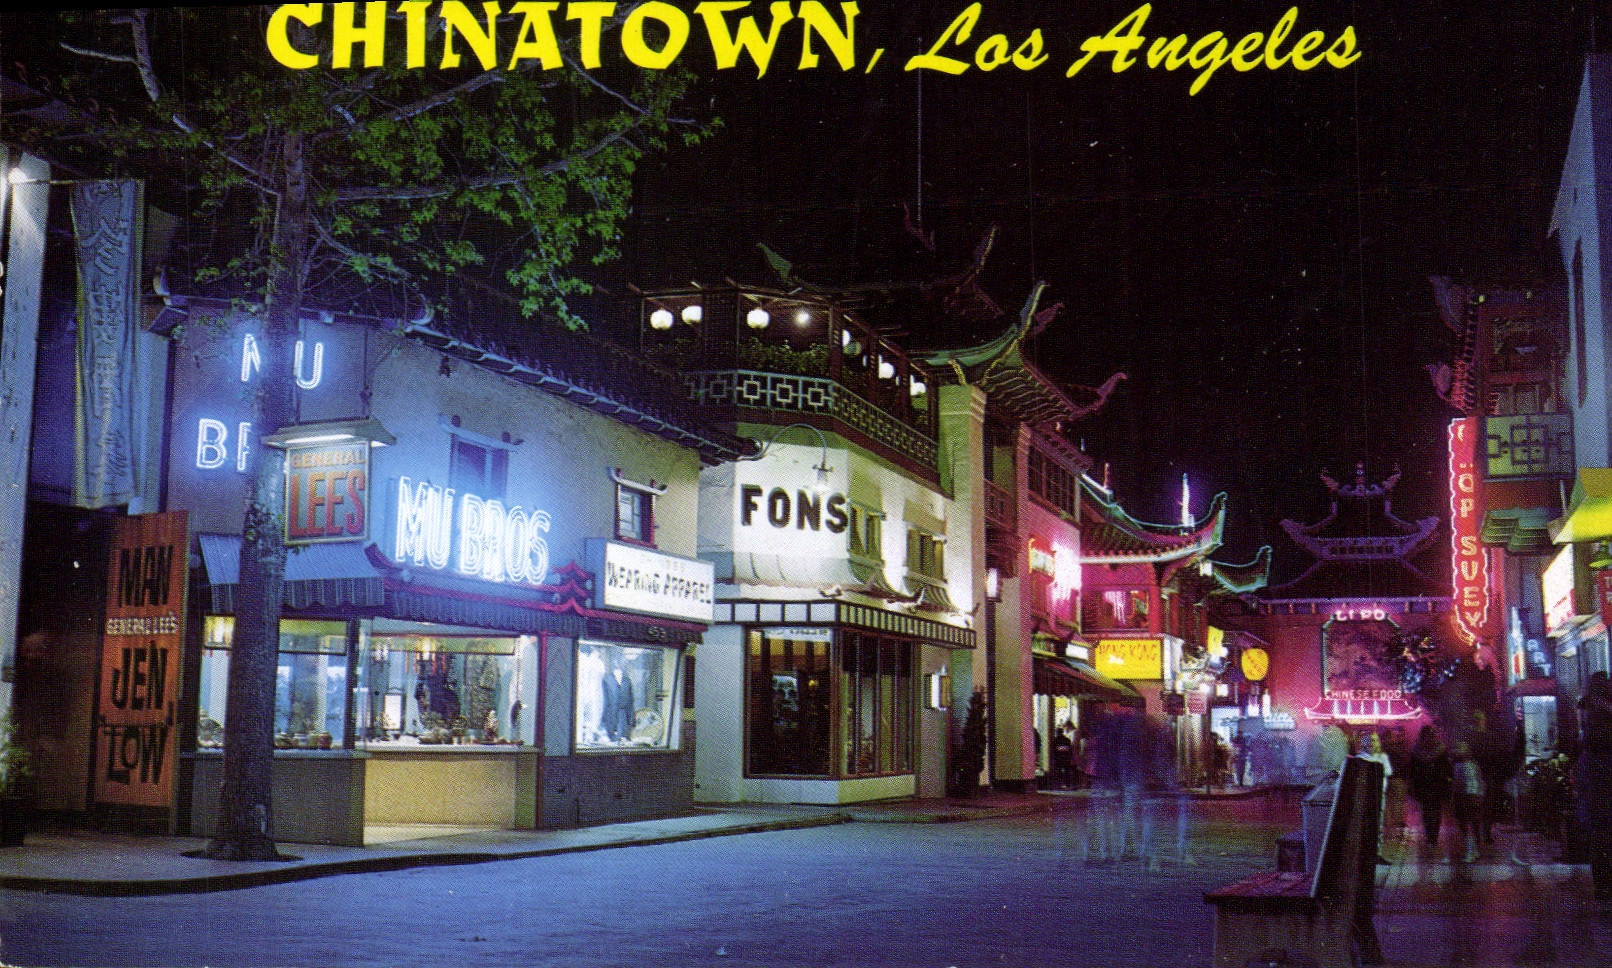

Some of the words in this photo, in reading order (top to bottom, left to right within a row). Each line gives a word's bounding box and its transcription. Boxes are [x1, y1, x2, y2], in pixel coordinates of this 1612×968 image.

[291, 449, 367, 469] GENERAL
[1457, 424, 1475, 519] COP
[289, 470, 366, 537] LEES
[396, 476, 456, 569] MU
[460, 493, 552, 586] BROS
[741, 484, 849, 534] FONS
[117, 545, 173, 608] MAN
[1460, 535, 1481, 628] SUEY
[110, 641, 168, 710] JEN
[1325, 689, 1370, 701] CHINESE
